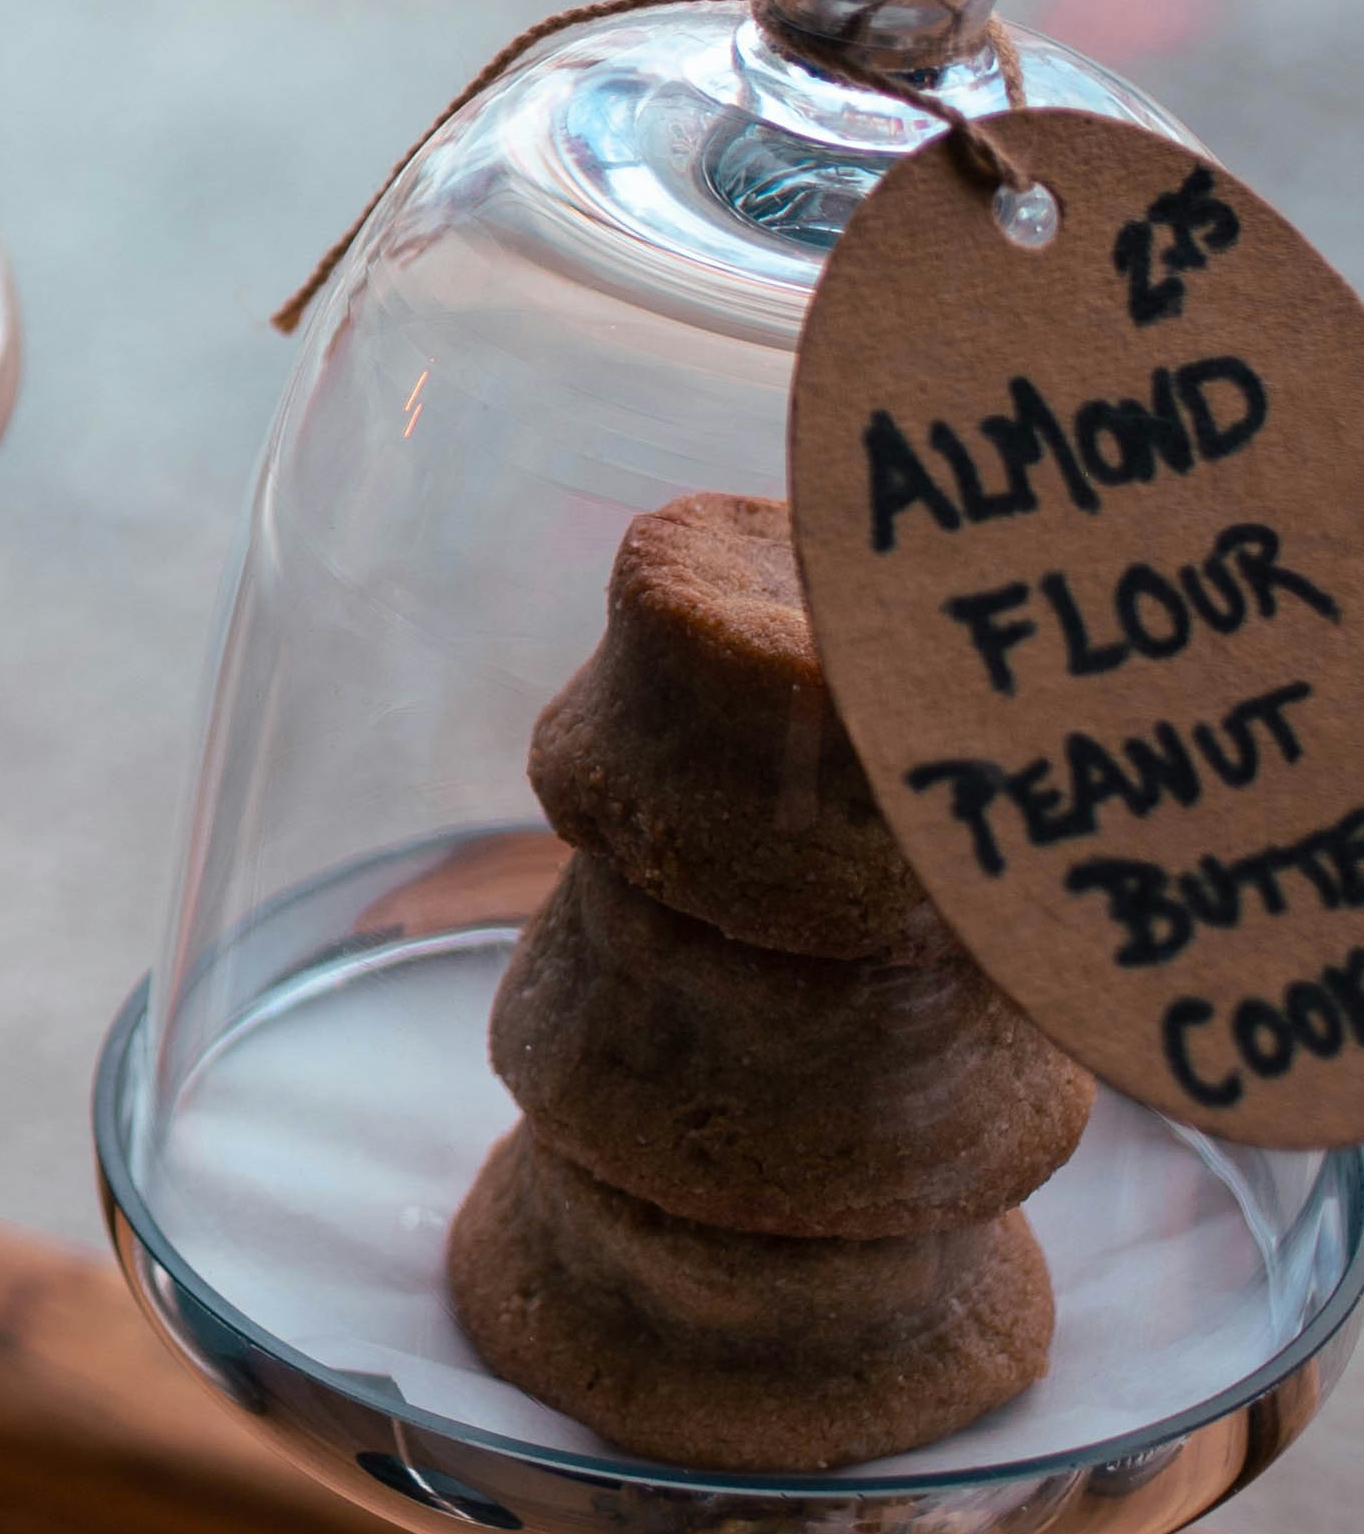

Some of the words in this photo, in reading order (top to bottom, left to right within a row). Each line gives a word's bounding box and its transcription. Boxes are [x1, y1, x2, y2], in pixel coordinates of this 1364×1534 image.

[863, 356, 1268, 554] ALMOND
[943, 524, 1342, 696] FLOUR
[907, 681, 1313, 877] PEANUT
